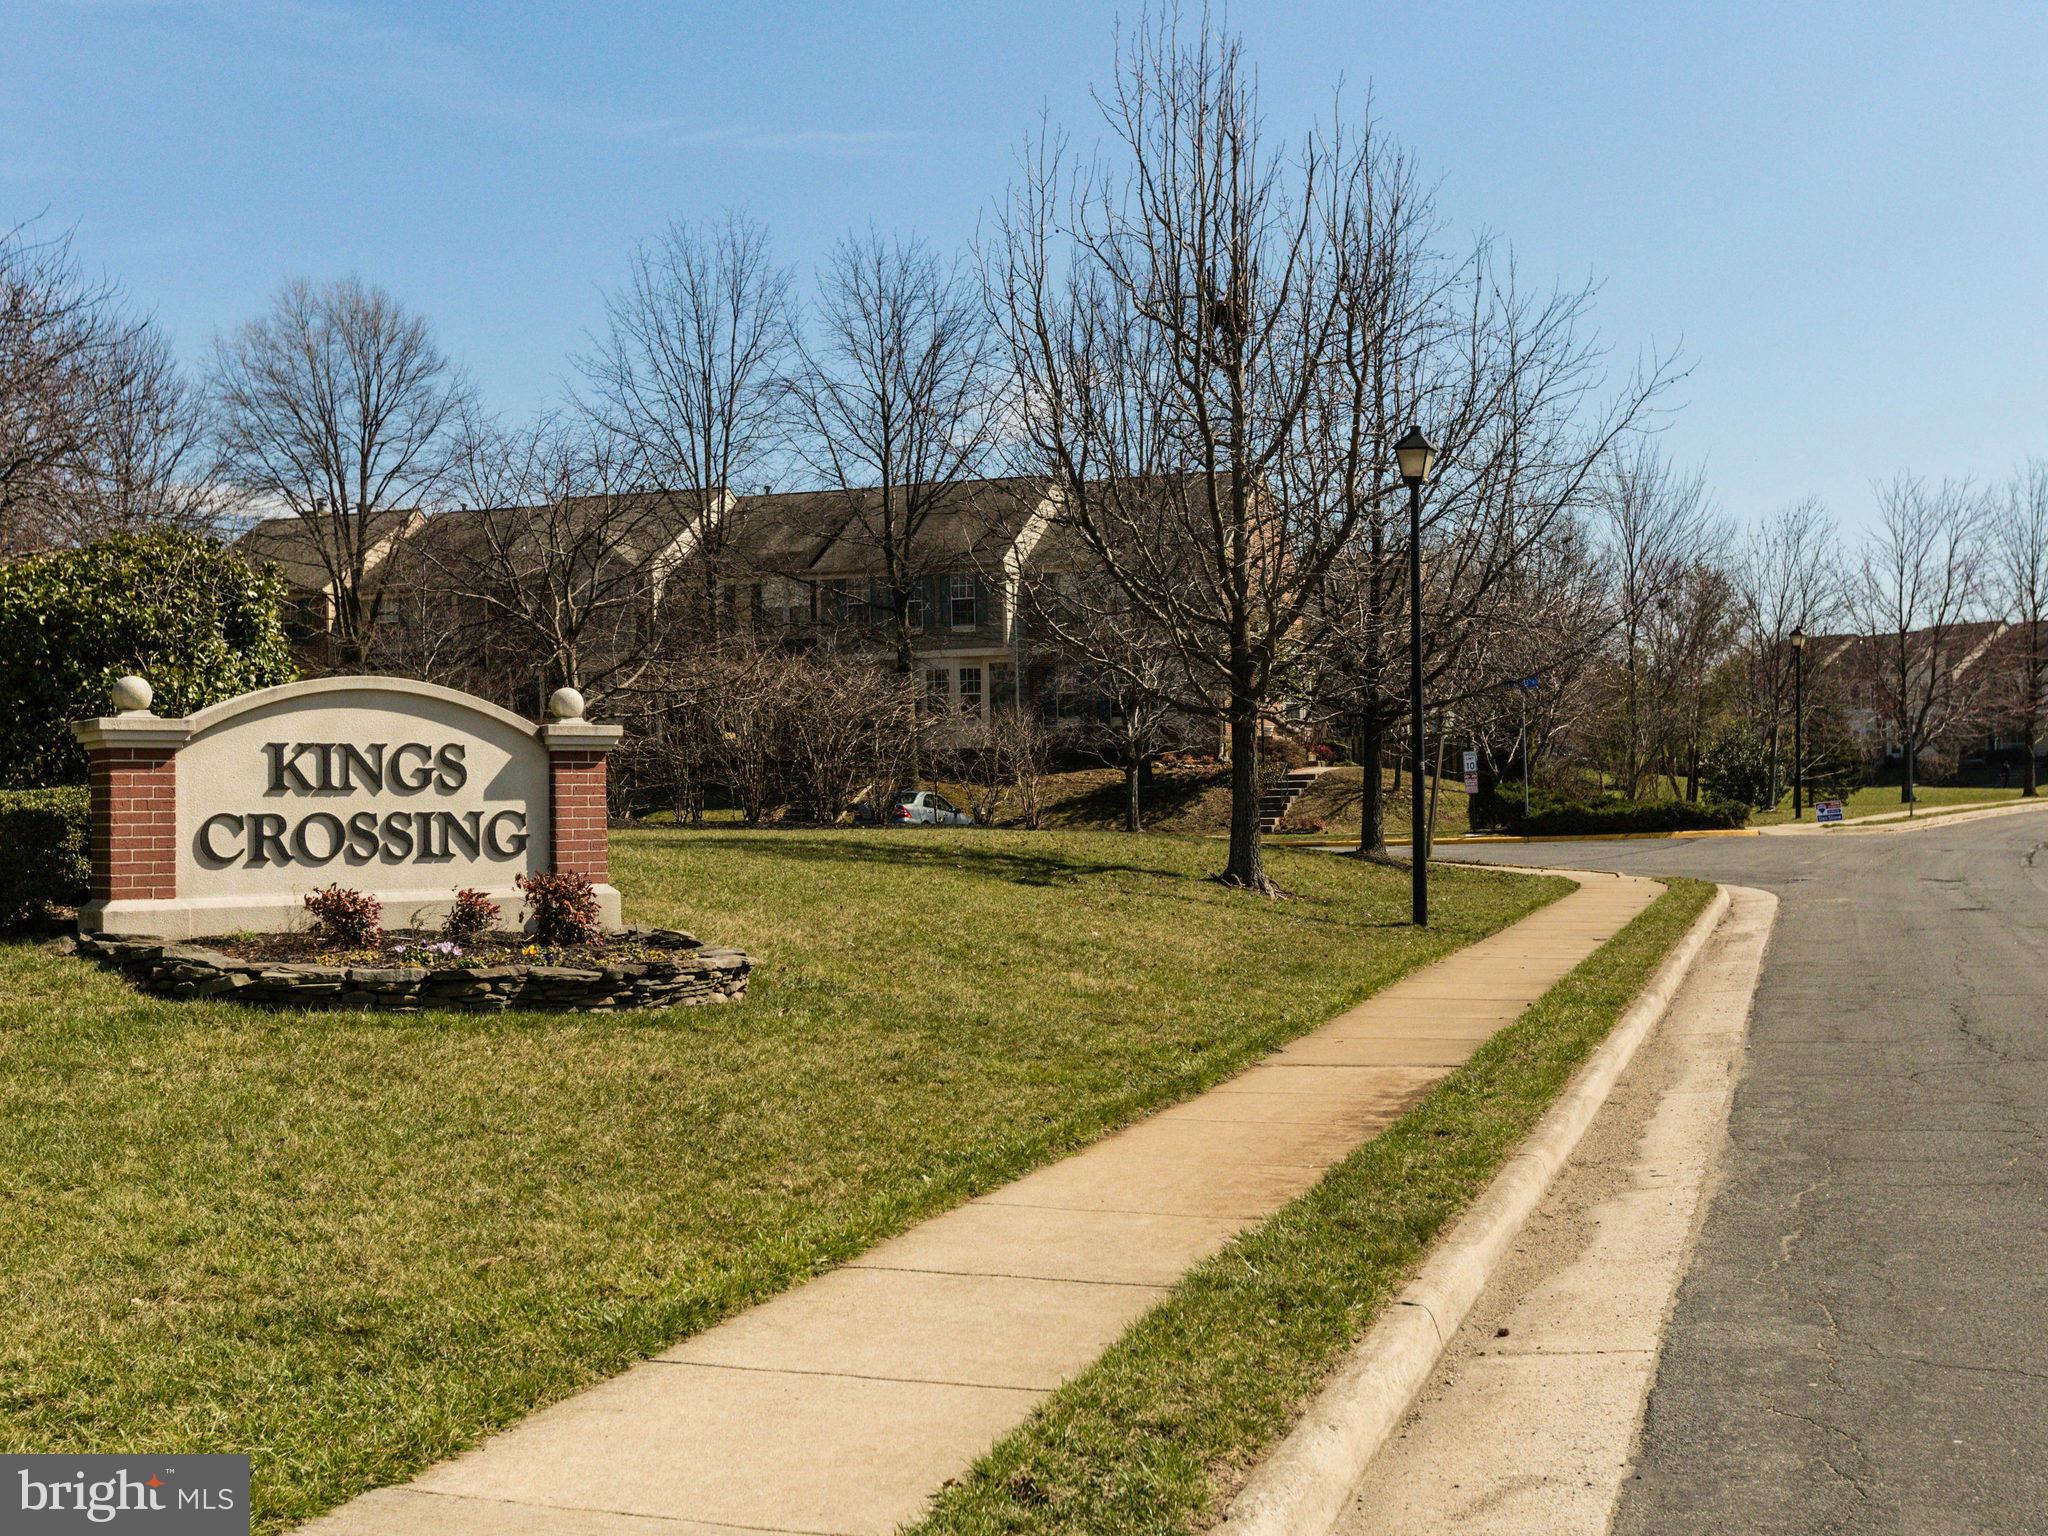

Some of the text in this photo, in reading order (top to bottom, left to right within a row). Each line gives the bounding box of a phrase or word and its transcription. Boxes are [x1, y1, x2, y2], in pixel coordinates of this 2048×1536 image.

[266, 742, 467, 792] KINGS
[1466, 762, 1475, 770] 10
[199, 810, 530, 863] CROSSING
